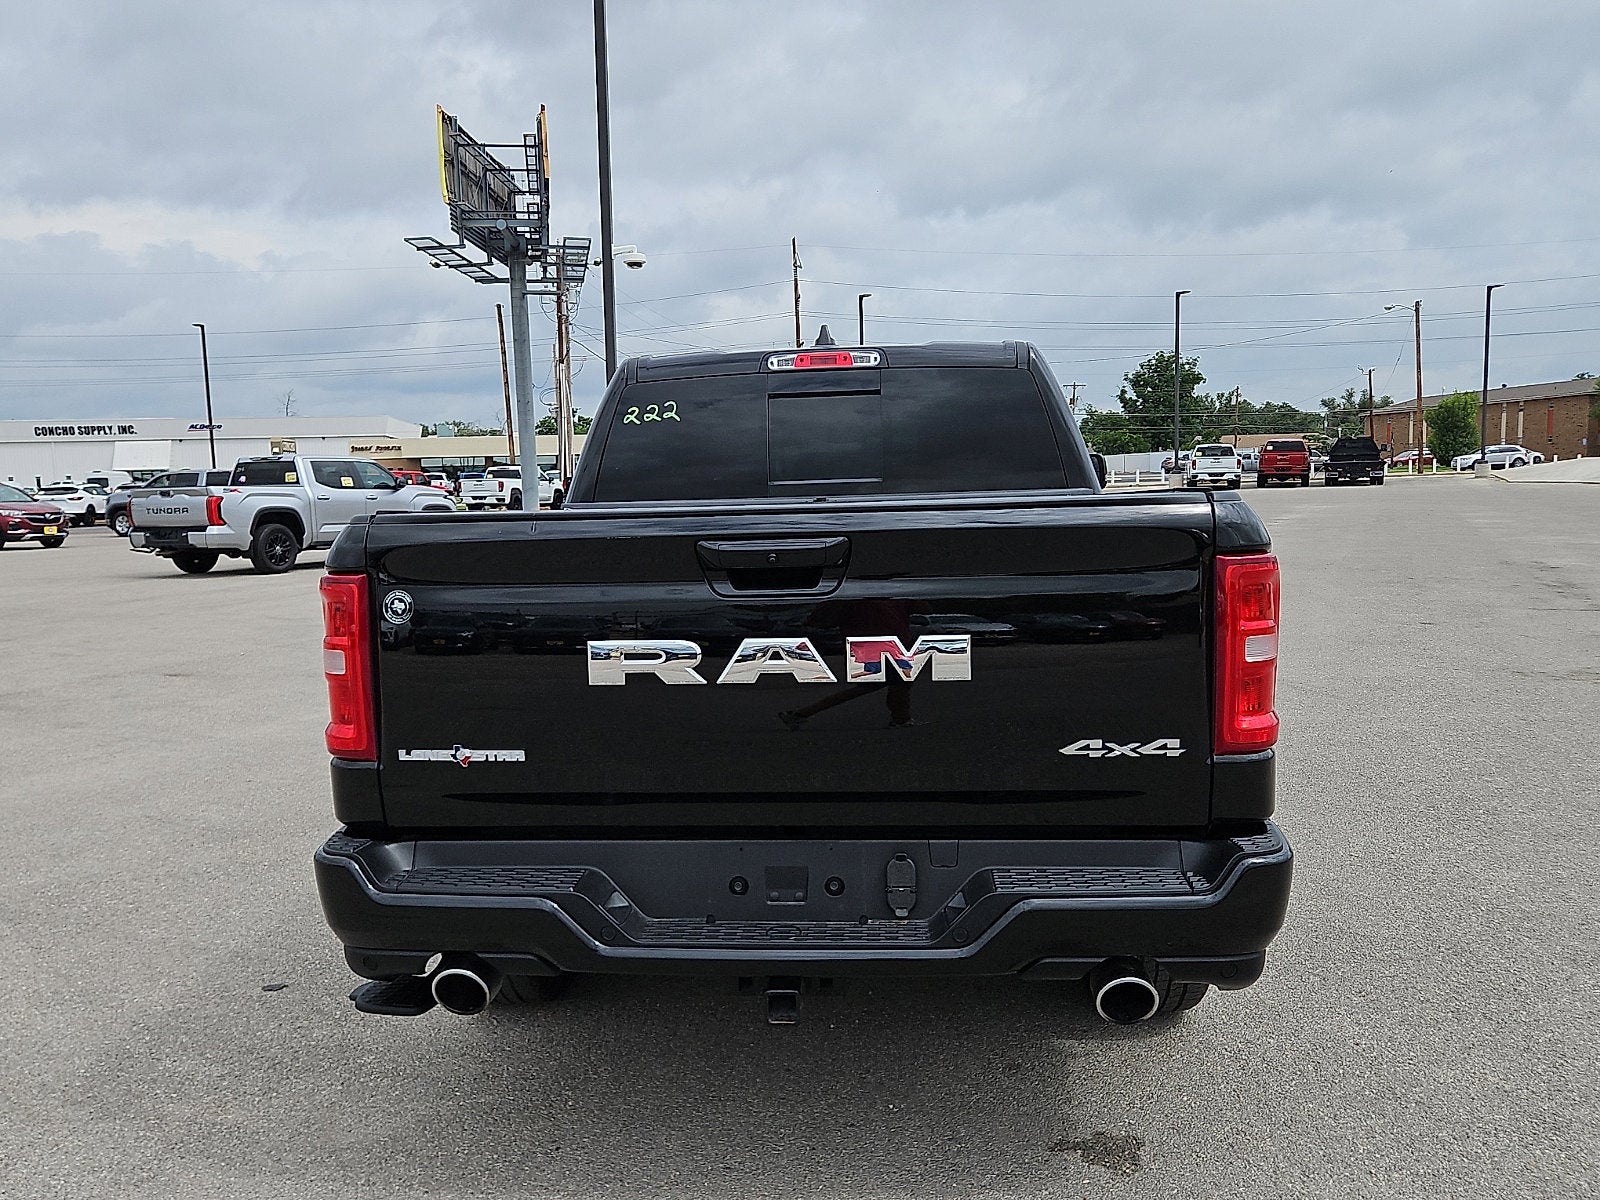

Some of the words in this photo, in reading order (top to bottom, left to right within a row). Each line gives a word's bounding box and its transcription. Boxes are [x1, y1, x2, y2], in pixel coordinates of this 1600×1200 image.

[623, 400, 681, 425] 222
[34, 426, 76, 437] CONCHO
[78, 425, 117, 437] SUPPLY,
[118, 424, 137, 435] INC.
[145, 507, 189, 515] TUNDRA
[586, 634, 973, 686] RAM
[398, 750, 450, 761] LONE
[470, 750, 526, 761] STAR
[1058, 738, 1187, 758] 4x4
